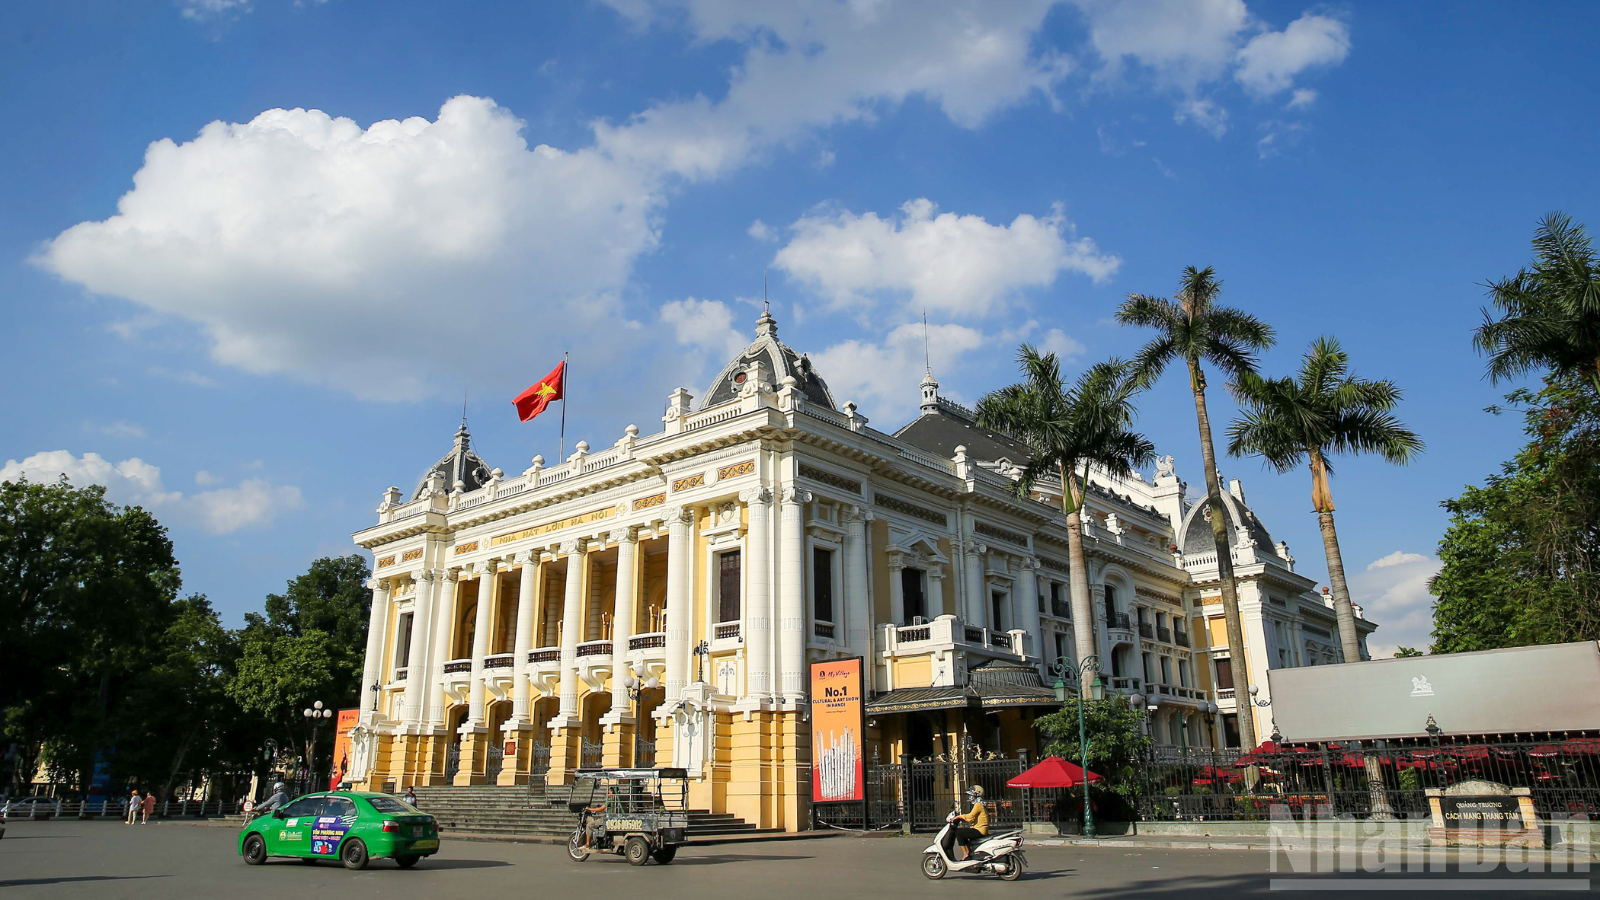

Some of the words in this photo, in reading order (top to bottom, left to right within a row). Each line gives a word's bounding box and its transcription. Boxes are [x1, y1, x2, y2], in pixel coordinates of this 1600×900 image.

[522, 528, 540, 538] HÁT
[590, 511, 609, 521] NỘI
[825, 686, 847, 697] No.1
[1446, 811, 1462, 819] CÁCH
[1482, 811, 1504, 819] THÁNG
[1504, 811, 1519, 819] TÁM
